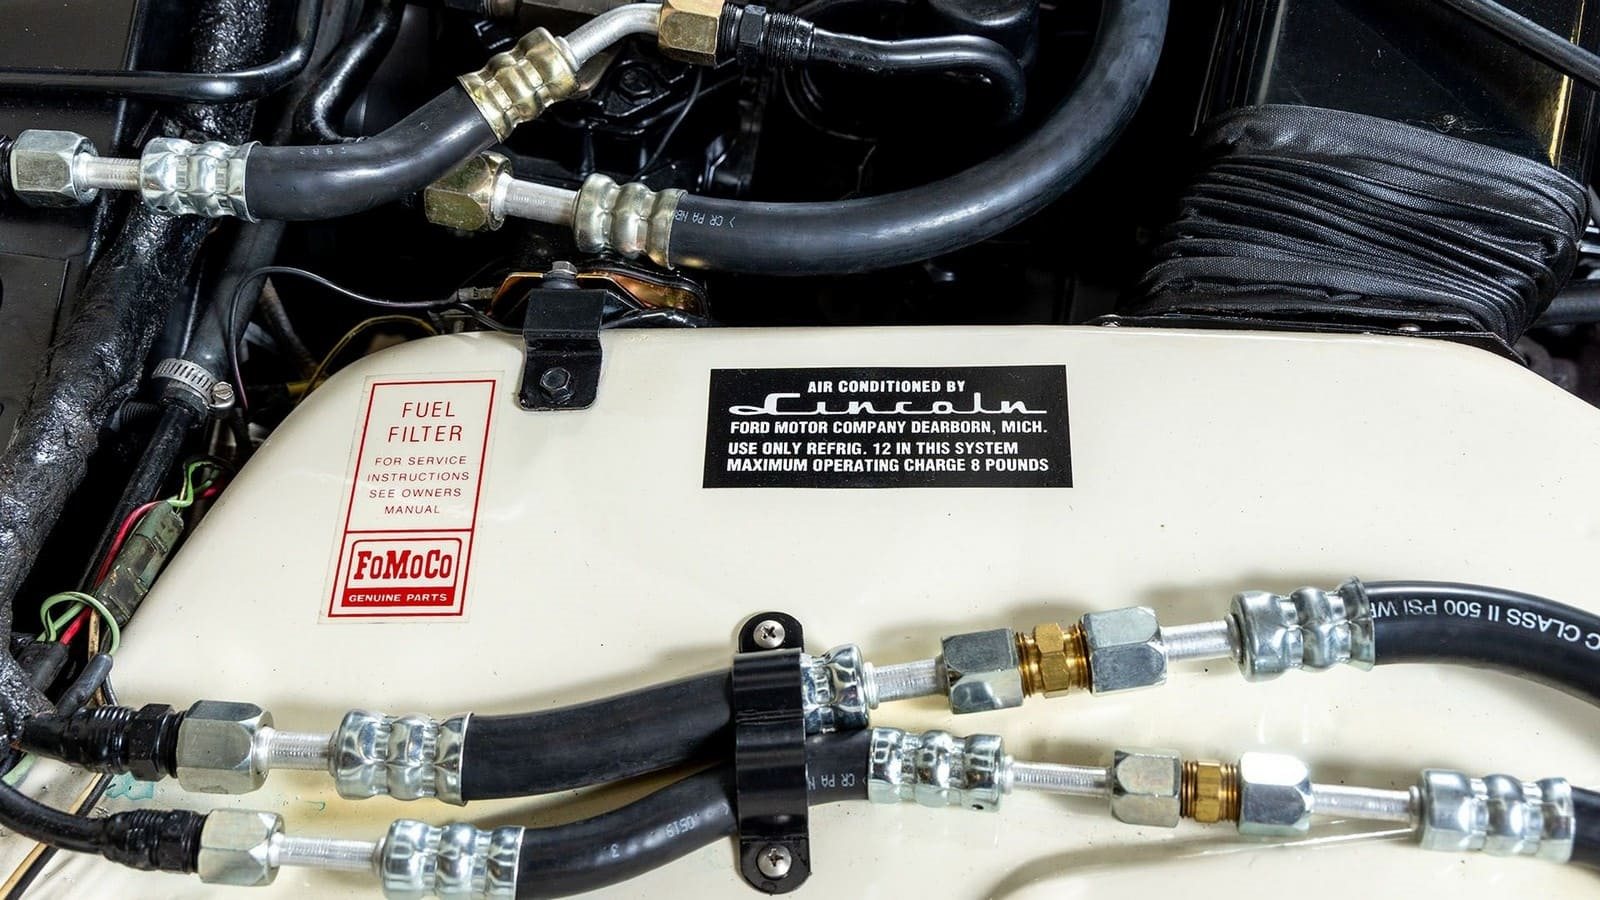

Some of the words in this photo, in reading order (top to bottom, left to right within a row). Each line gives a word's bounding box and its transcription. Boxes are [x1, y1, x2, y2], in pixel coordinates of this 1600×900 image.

[691, 211, 706, 225] PA
[709, 214, 724, 227] CR
[807, 380, 833, 393] AIR
[837, 380, 941, 393] CONDITIONED
[946, 380, 965, 392] BY
[402, 401, 455, 418] FUEL
[728, 392, 1047, 416] Lincoln
[388, 425, 462, 442] FILTER
[730, 421, 770, 434] FORD
[774, 421, 828, 434] MOTOR
[832, 421, 906, 434] COMPANY
[911, 420, 996, 435] DEARBORN,
[1001, 420, 1048, 433] MICH.
[728, 442, 757, 455] USE
[762, 442, 801, 455] ONLY
[806, 442, 867, 455] REFRIG.
[872, 442, 891, 455] 12
[896, 442, 911, 455] IN
[916, 442, 950, 455] THIS
[955, 442, 1018, 454] SYSTEM
[375, 457, 402, 466] FOR
[408, 456, 467, 465] SERVICE
[726, 458, 808, 472] MAXIMUM
[812, 458, 899, 472] OPERATING
[904, 458, 966, 471] CHARGE
[971, 458, 980, 471] 8
[985, 458, 1049, 471] POUNDS
[367, 472, 469, 482] INSTRUCTIONS
[369, 489, 395, 498] SEE
[402, 488, 462, 498] OWNERS
[384, 505, 440, 514] MANUAL
[353, 549, 453, 580] FoMoCo
[349, 594, 401, 602] GENUINE
[406, 593, 447, 602] PARTS
[1402, 598, 1438, 616] PSI
[1443, 598, 1482, 618] 500
[1487, 604, 1500, 623] II
[1506, 607, 1581, 642] CLASS
[820, 772, 836, 788] PA
[840, 772, 855, 788] CR
